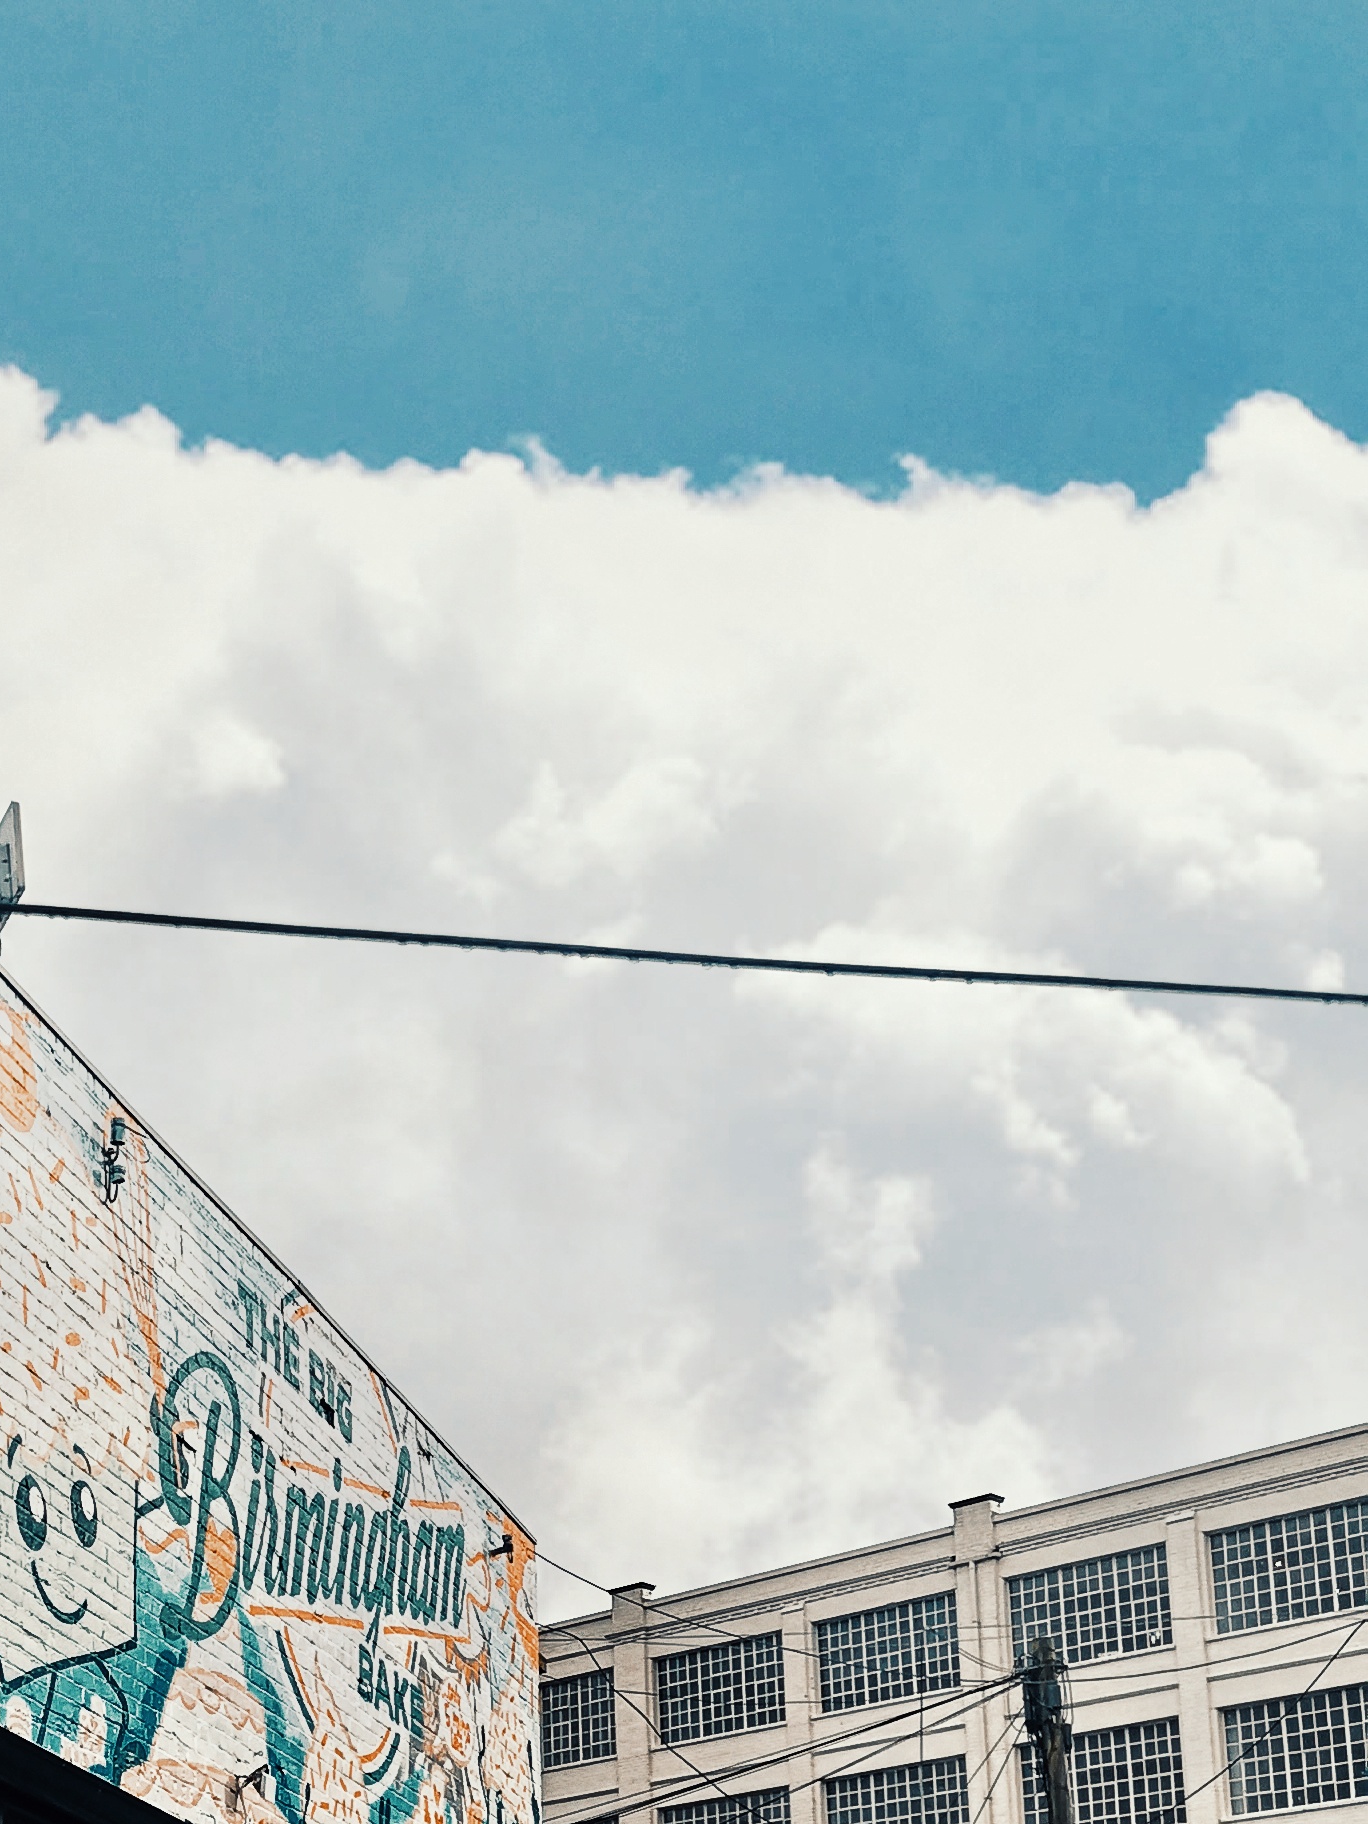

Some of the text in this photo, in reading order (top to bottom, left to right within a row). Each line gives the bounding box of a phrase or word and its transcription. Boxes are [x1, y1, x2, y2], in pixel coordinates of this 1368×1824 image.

[237, 1278, 353, 1444] THE BIG
[149, 1351, 466, 1657] Birmingham
[357, 1643, 424, 1740] BAKE
